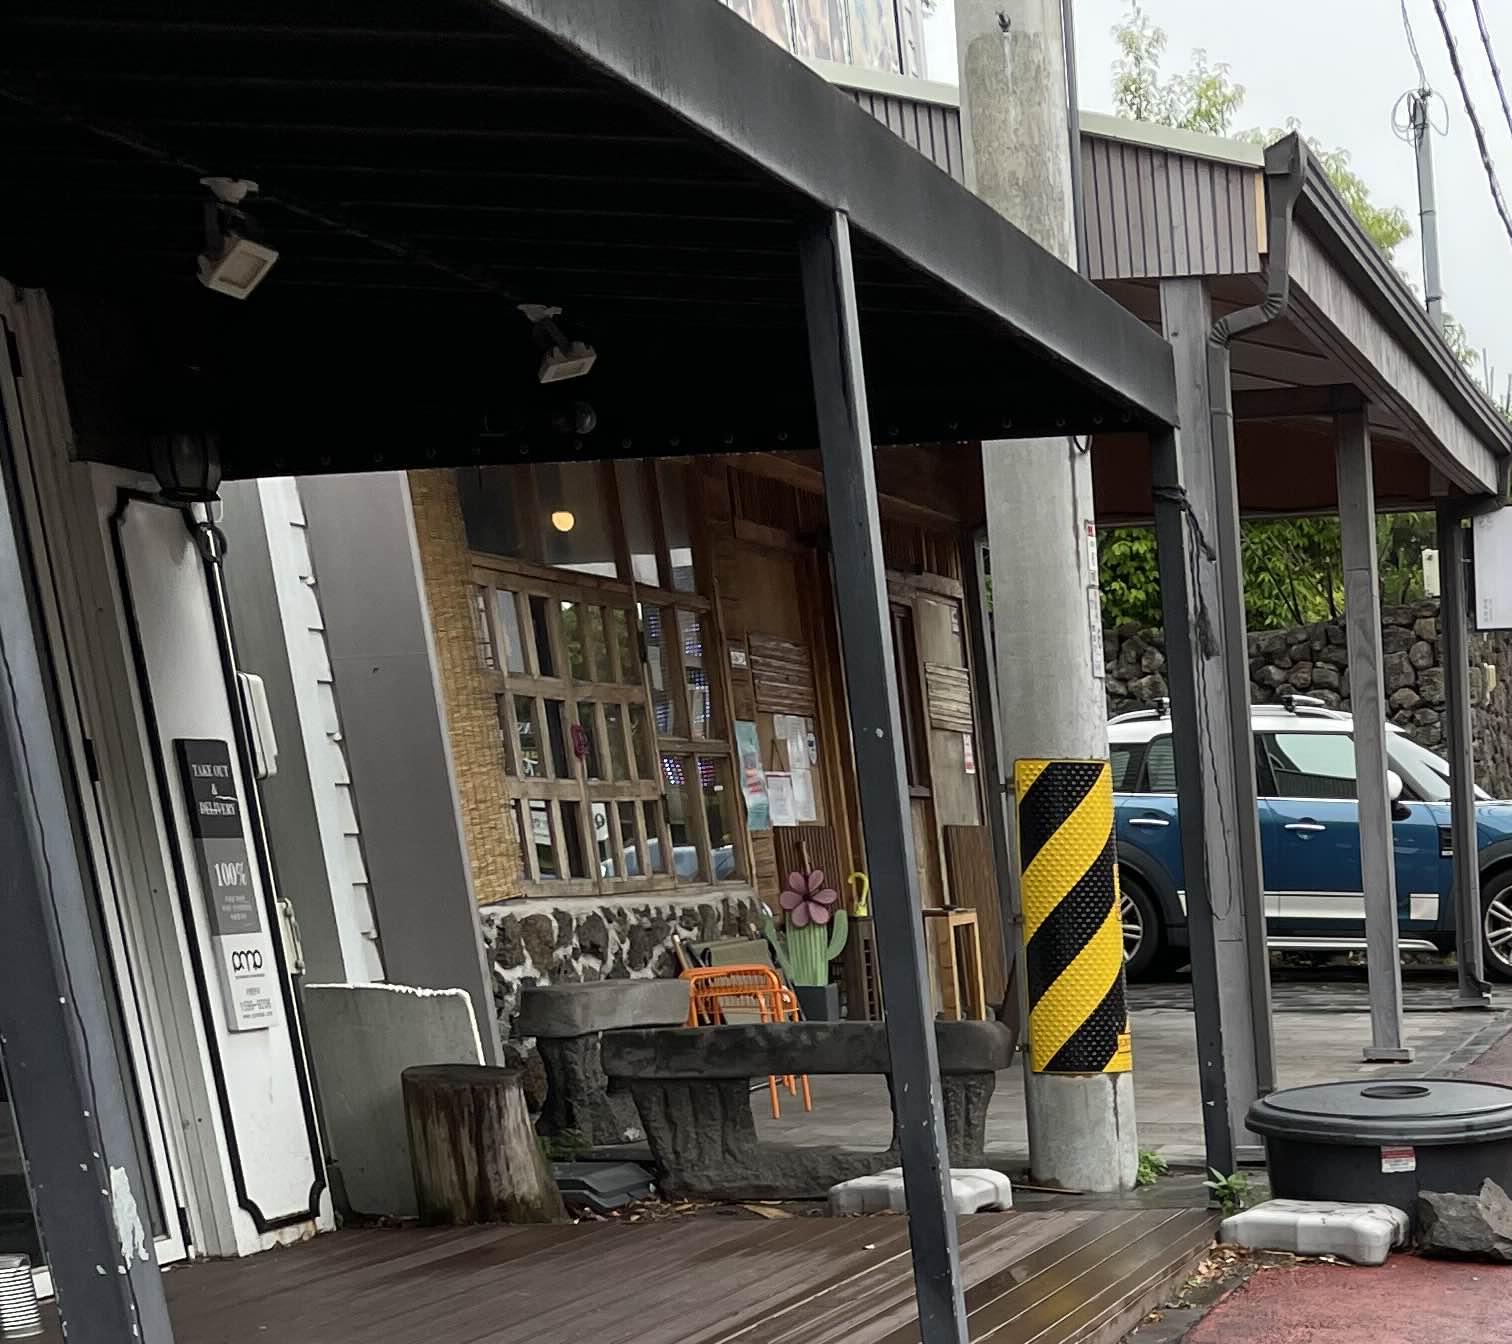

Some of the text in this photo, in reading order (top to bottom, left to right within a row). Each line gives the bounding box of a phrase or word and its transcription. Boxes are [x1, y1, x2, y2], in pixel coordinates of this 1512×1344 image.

[192, 764, 229, 777] TAKE OUT
[199, 801, 236, 816] DELIVERY
[215, 862, 247, 887] 100%
